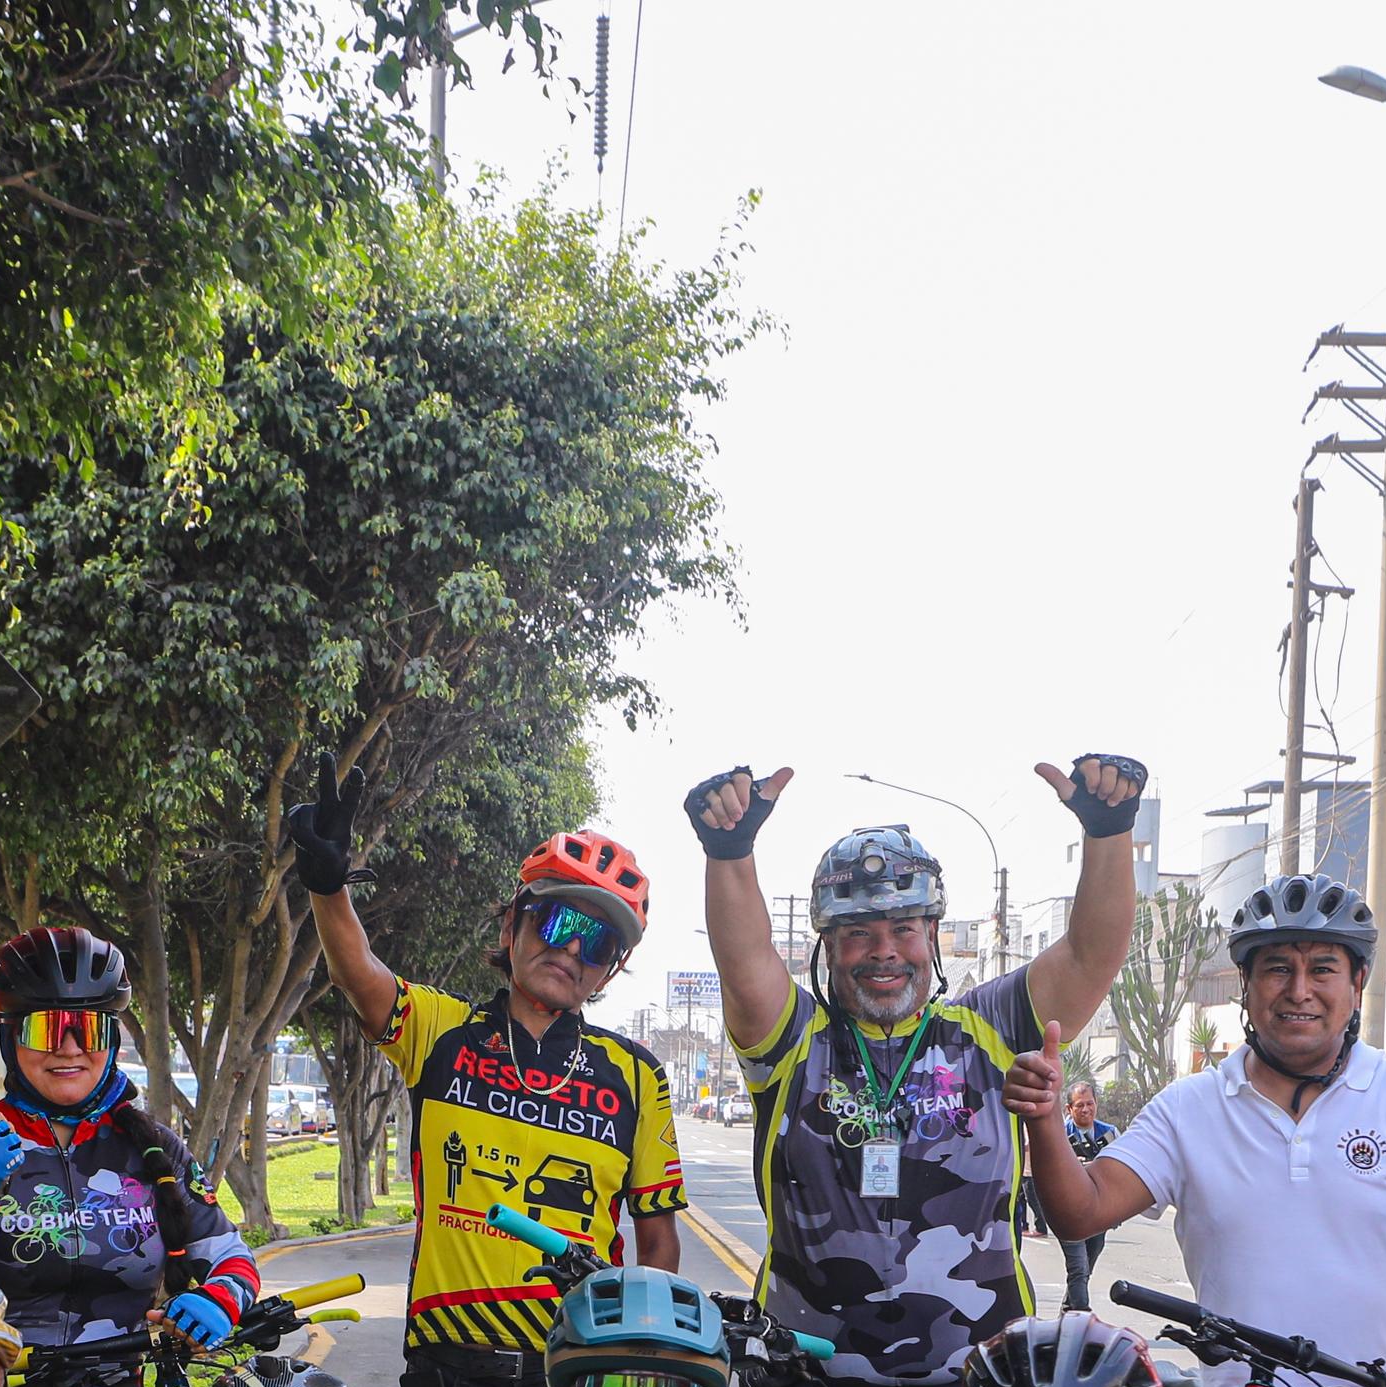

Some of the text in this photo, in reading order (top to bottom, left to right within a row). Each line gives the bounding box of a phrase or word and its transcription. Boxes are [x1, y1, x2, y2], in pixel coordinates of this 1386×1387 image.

[453, 1045, 621, 1116] RESPETO
[445, 1077, 618, 1146] AL CICLISTA
[911, 1092, 964, 1116] TEAM
[476, 1144, 520, 1167] 1.5 m
[40, 1208, 95, 1231] BIKE
[100, 1205, 155, 1227] TEAM
